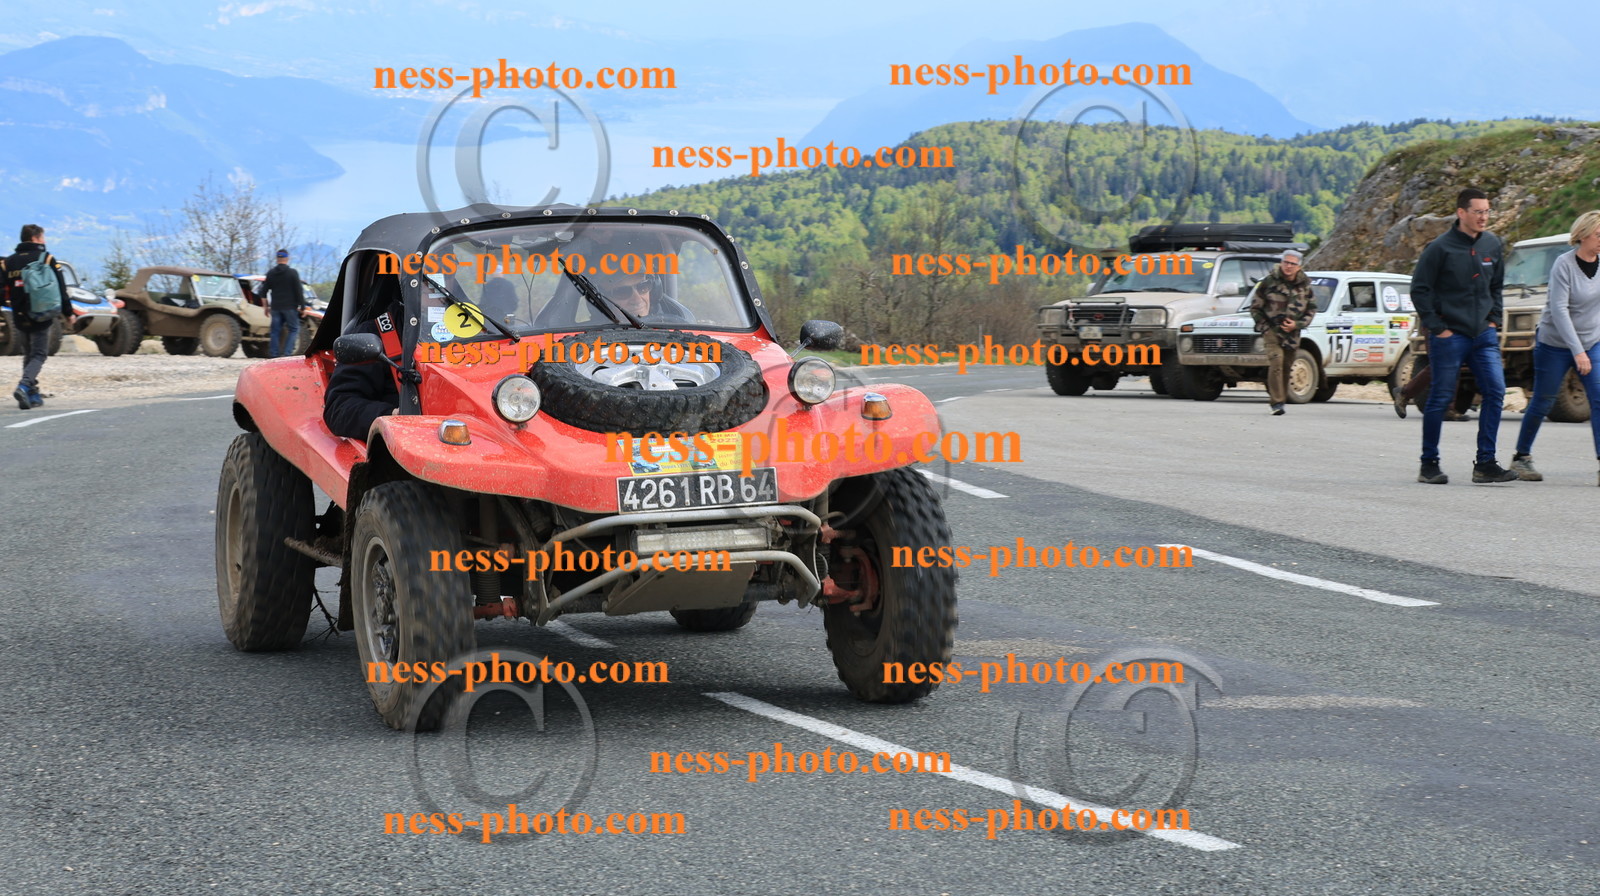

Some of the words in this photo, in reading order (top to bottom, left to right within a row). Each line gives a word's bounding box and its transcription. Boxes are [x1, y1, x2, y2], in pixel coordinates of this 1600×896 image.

[457, 312, 472, 328] 2
[1328, 335, 1353, 363] 157
[623, 476, 691, 510] 4261
[699, 474, 735, 505] RB
[740, 471, 774, 502] 64
